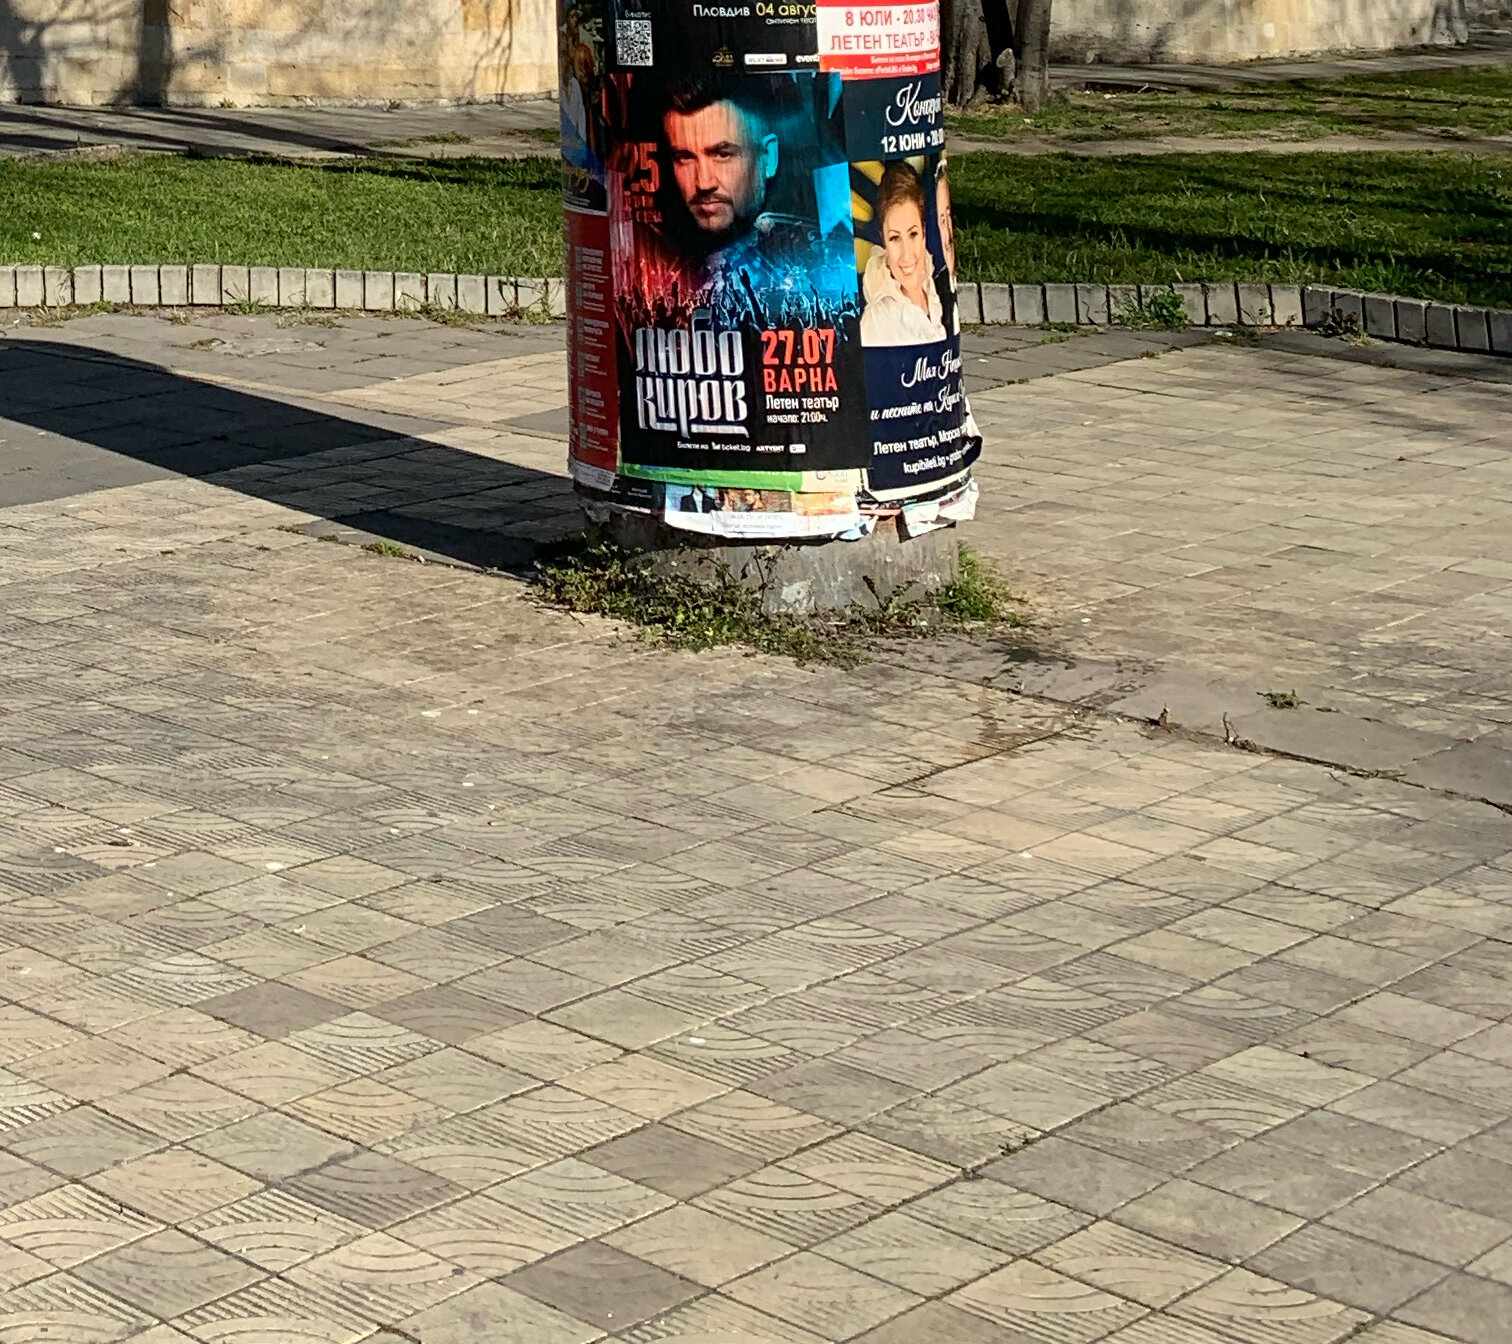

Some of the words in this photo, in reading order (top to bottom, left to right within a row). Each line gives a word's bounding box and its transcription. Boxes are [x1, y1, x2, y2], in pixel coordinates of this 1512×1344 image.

[693, 4, 750, 17] Пловдив
[755, 3, 774, 16] 04
[845, 11, 854, 26] 8
[860, 11, 892, 26] ЮЛИ
[830, 35, 882, 50] ЛЕТЕН
[886, 32, 925, 48] ТЕАТЪР
[881, 136, 897, 153] 12
[899, 132, 925, 152] ЮНИ
[761, 329, 836, 365] 27.07
[763, 366, 838, 393] ВАРНА
[766, 395, 799, 410] Летен
[801, 396, 839, 411] театър
[873, 441, 907, 456] Летен
